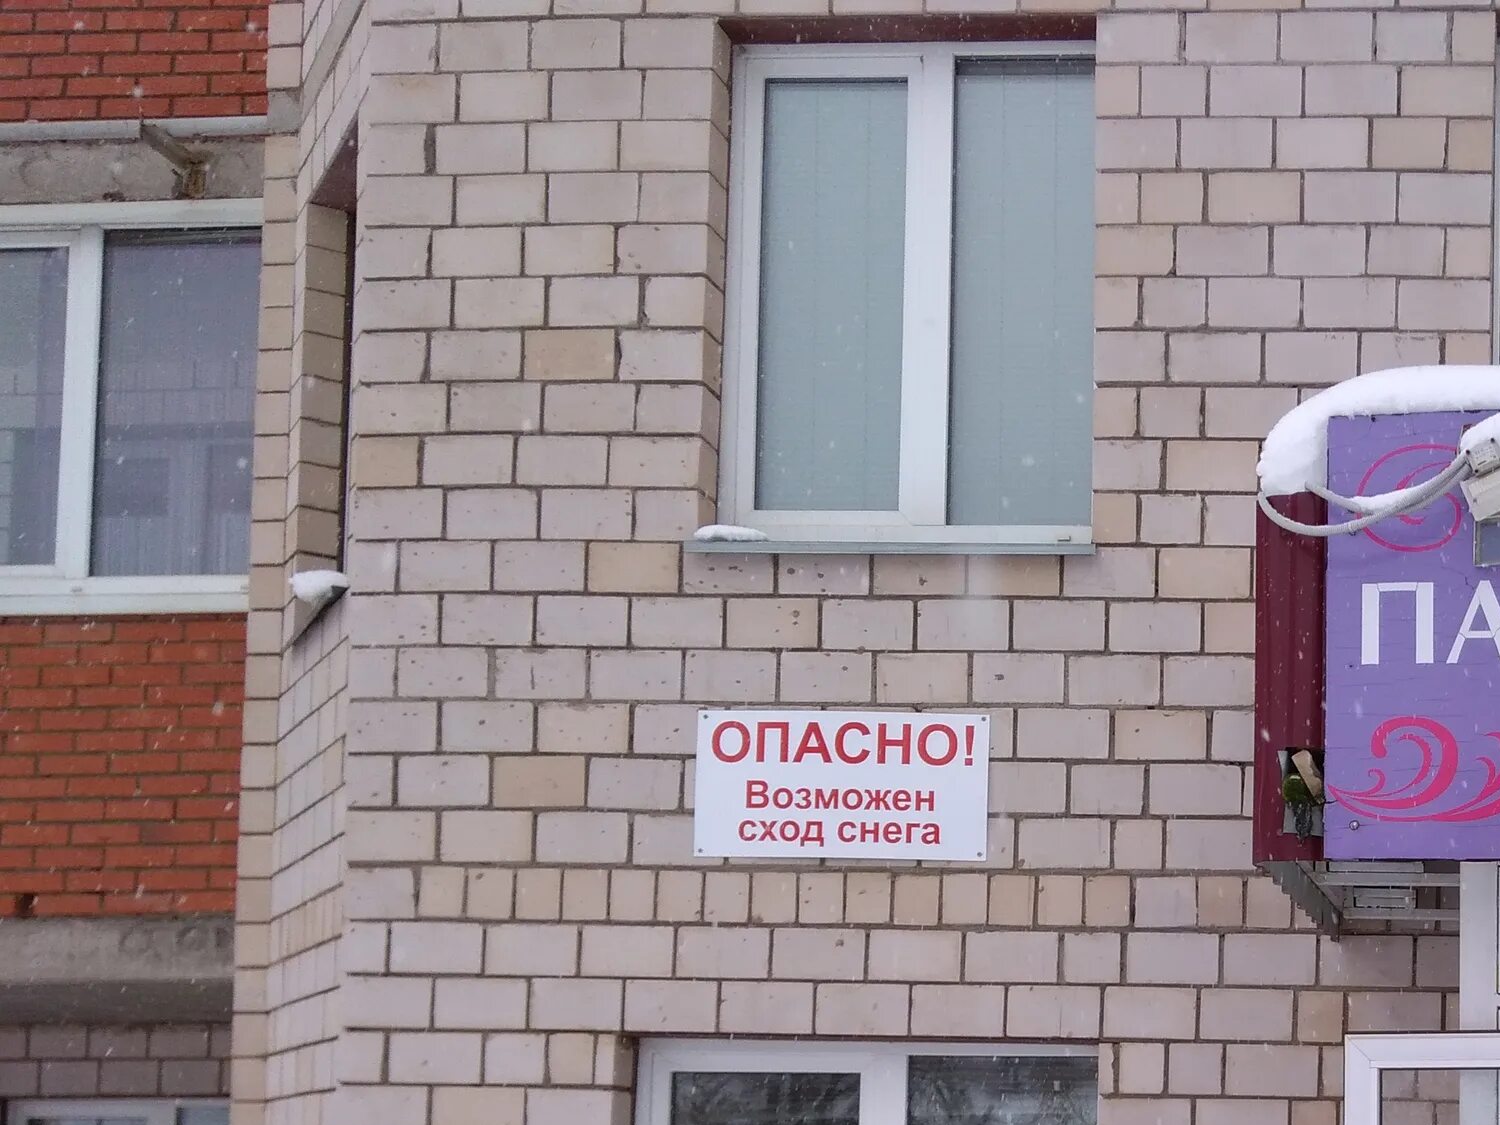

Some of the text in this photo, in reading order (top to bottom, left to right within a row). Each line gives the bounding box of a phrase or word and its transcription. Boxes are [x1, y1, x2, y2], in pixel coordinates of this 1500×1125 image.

[711, 720, 975, 767] ОПАСНО!
[745, 779, 935, 812] Возможен
[738, 818, 941, 847] сход снега
